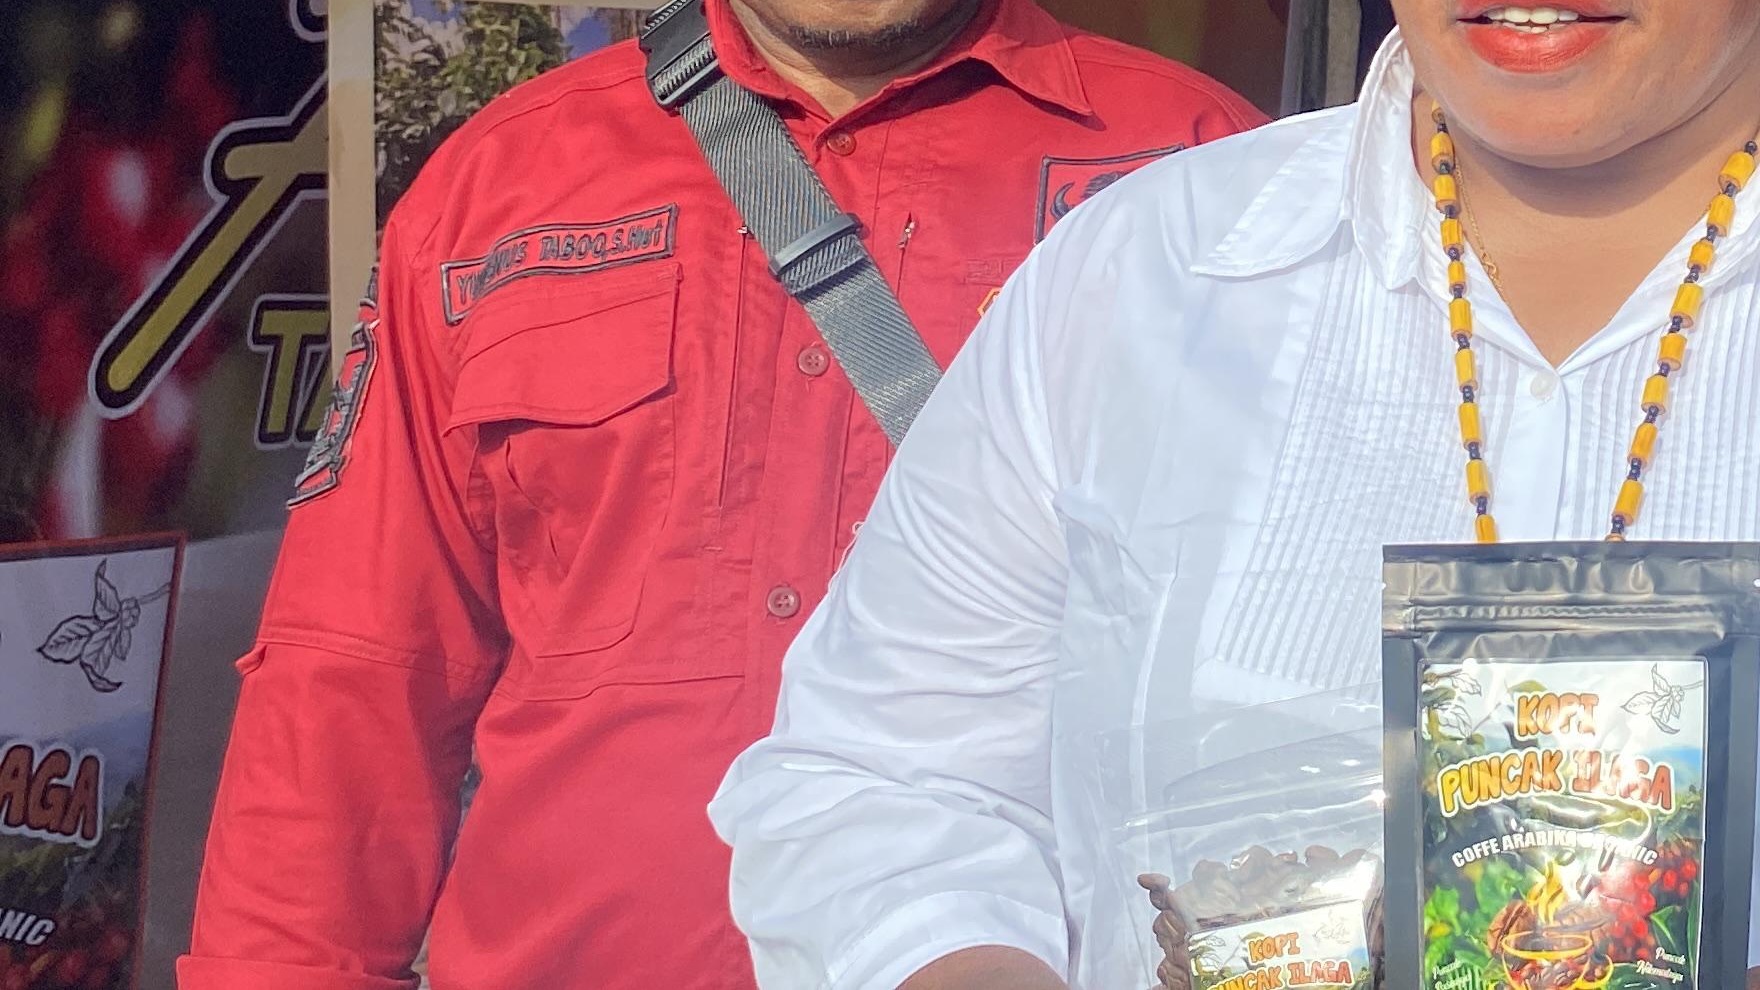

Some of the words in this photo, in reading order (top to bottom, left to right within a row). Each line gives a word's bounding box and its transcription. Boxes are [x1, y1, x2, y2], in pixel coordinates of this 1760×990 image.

[1517, 693, 1599, 737] KOPI
[1441, 749, 1564, 815] PUNCAK
[1451, 838, 1501, 869] COFFE
[1501, 829, 1577, 853] ARABIKA
[1249, 932, 1300, 962] KOPI
[1287, 960, 1353, 986] ILAGA
